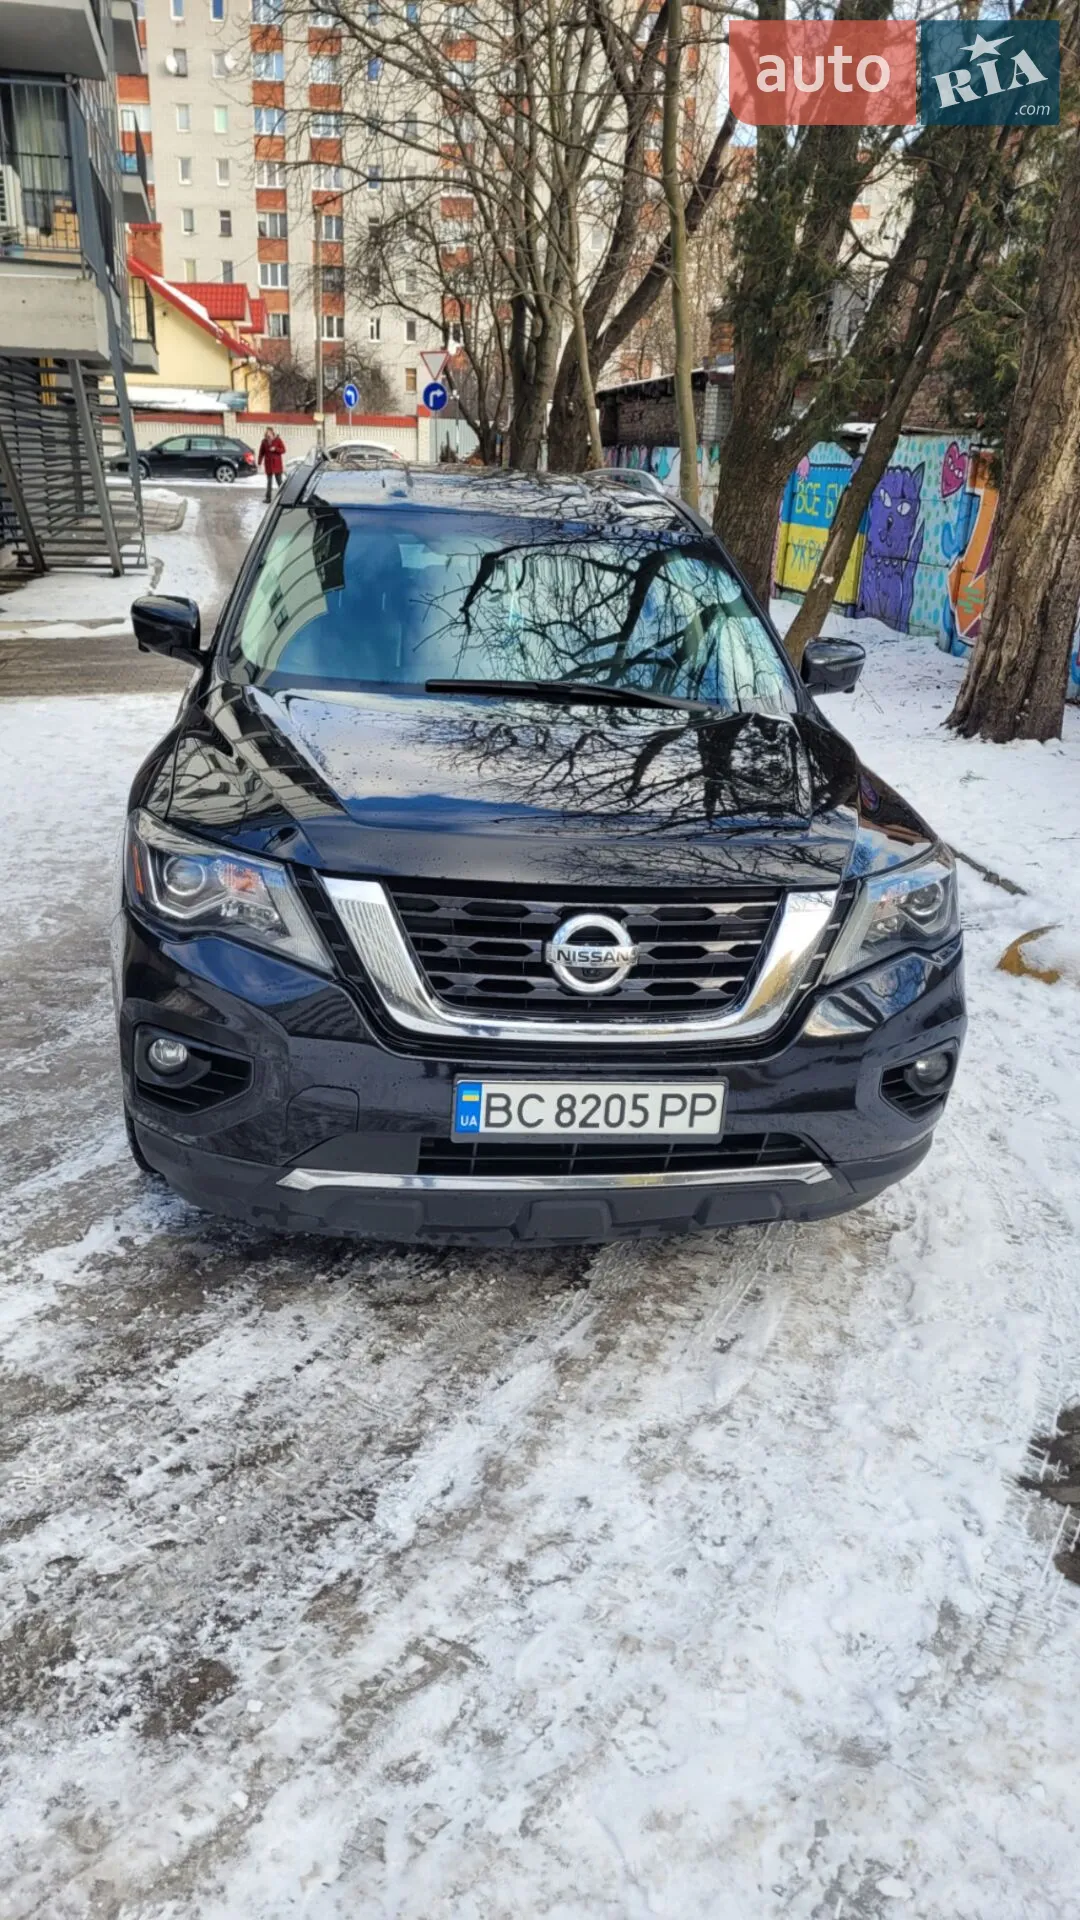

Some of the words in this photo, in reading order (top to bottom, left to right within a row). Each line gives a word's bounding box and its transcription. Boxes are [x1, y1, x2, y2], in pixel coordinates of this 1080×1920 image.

[795, 481, 821, 516] ВСЕ
[825, 483, 844, 519] БУ
[557, 950, 629, 963] NISSAN
[460, 1115, 478, 1127] UA
[484, 1093, 545, 1128] BC
[554, 1093, 649, 1128] 8205
[658, 1093, 717, 1128] PP
